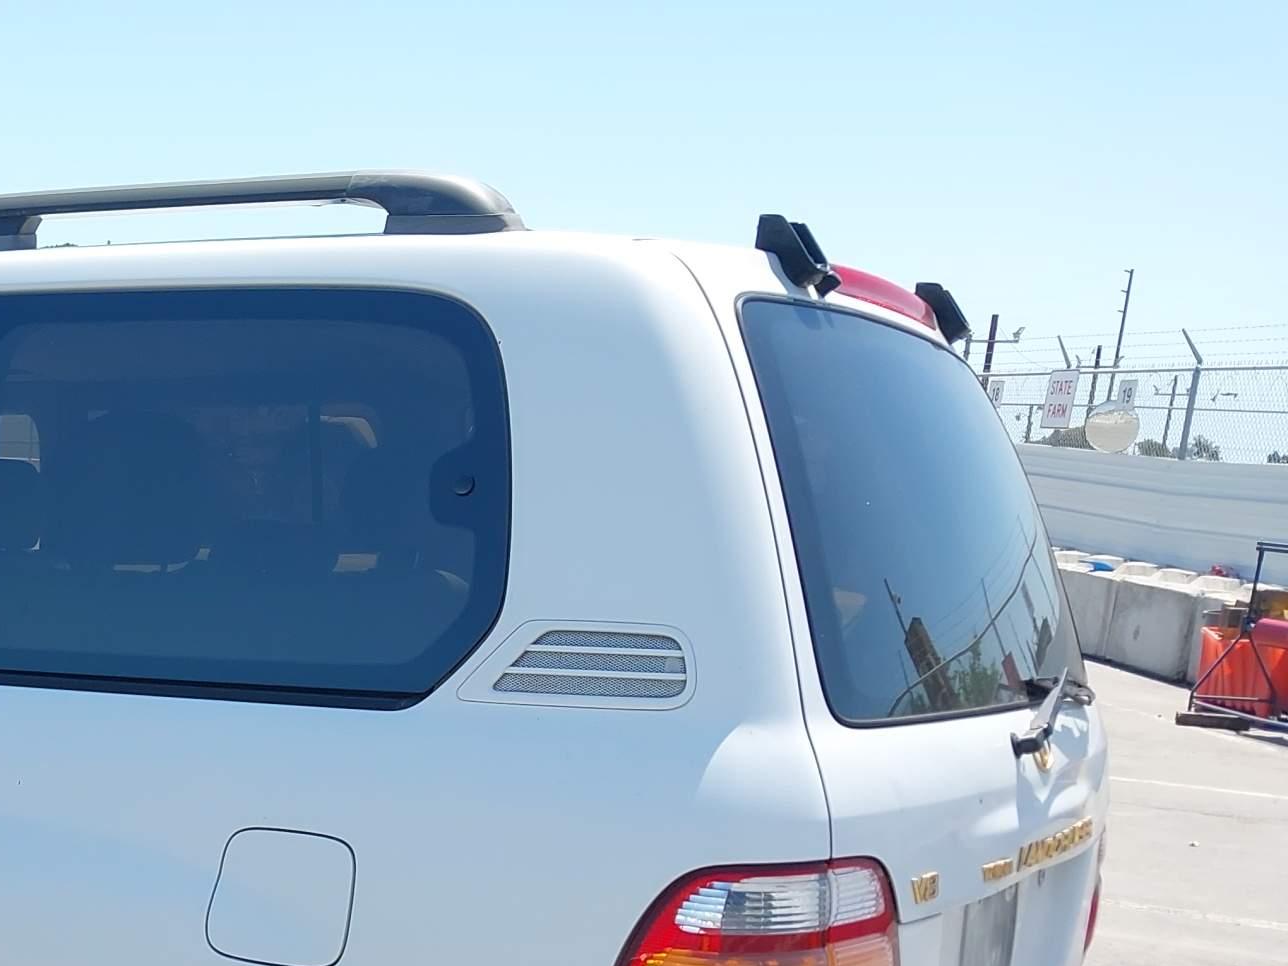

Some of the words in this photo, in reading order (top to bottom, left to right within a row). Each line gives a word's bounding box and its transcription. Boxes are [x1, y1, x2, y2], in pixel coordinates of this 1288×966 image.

[991, 387, 1000, 402] 18
[1050, 380, 1073, 395] STATE
[1122, 387, 1133, 404] 19
[1047, 403, 1067, 417] FARM
